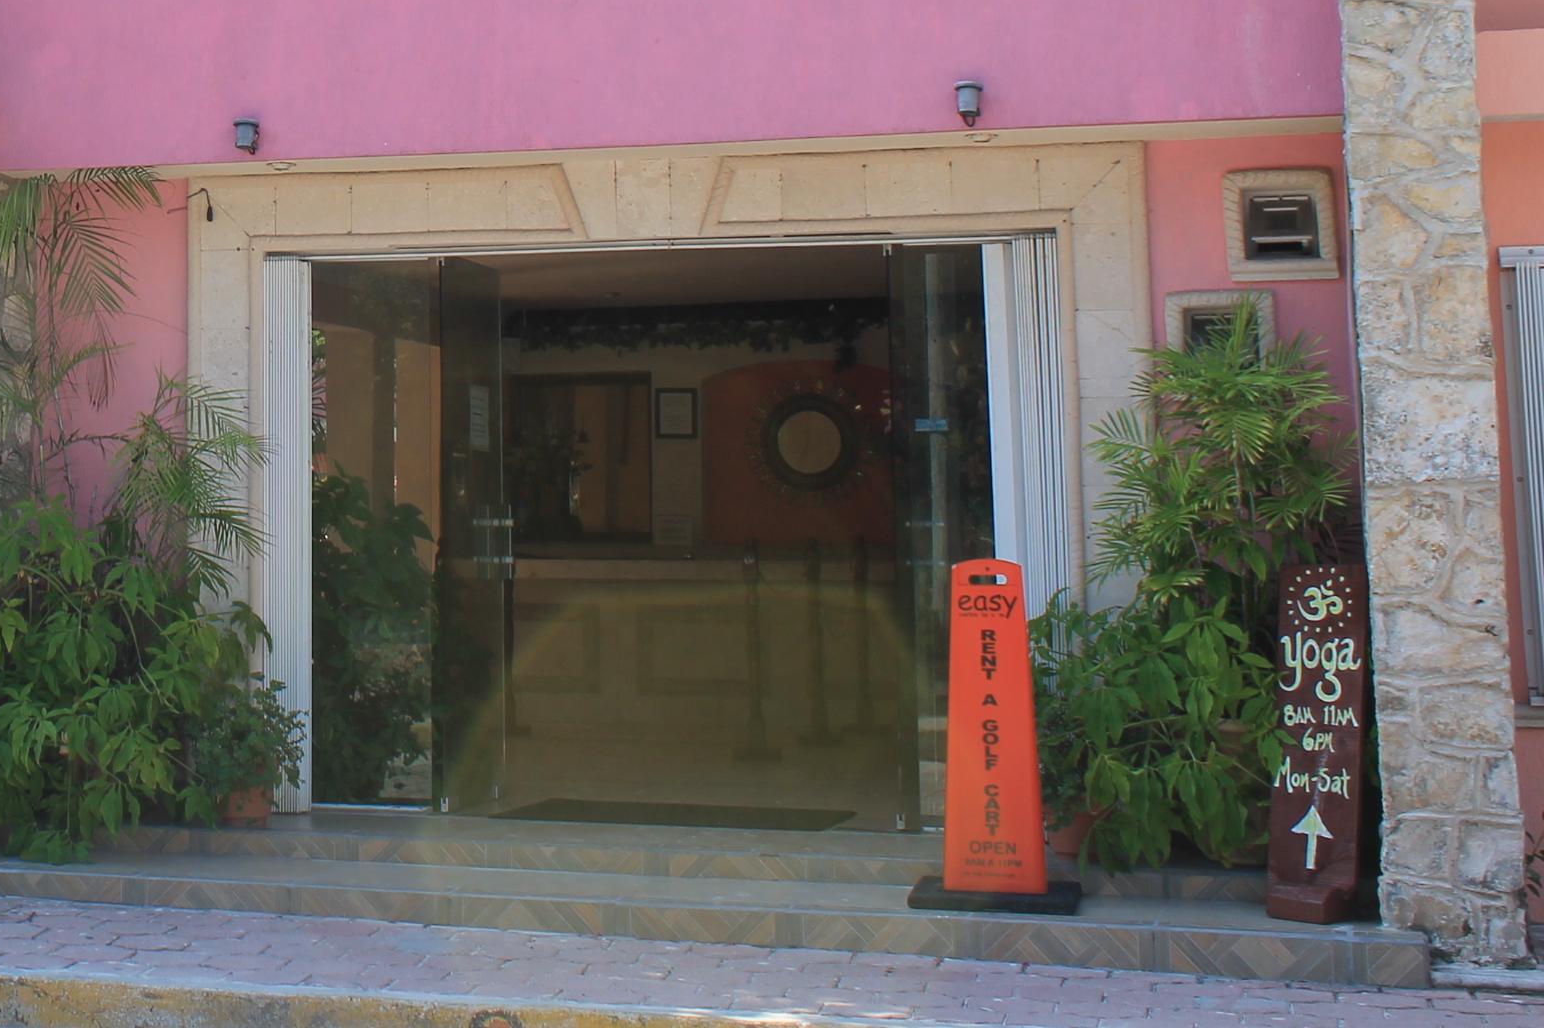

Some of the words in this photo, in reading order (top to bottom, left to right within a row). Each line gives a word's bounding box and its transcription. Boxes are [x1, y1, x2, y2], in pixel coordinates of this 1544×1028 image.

[958, 594, 1017, 619] easy
[981, 629, 997, 680] RENT
[1278, 631, 1362, 703] yoga
[982, 694, 997, 706] A
[1283, 704, 1316, 726] 8AM
[1323, 705, 1359, 727] 11AM
[982, 720, 999, 771] GOLF
[1302, 727, 1335, 752] 6PM
[1274, 756, 1351, 800] Mon-Sat
[984, 784, 1000, 836] CART
[969, 840, 1017, 855] OPEN
